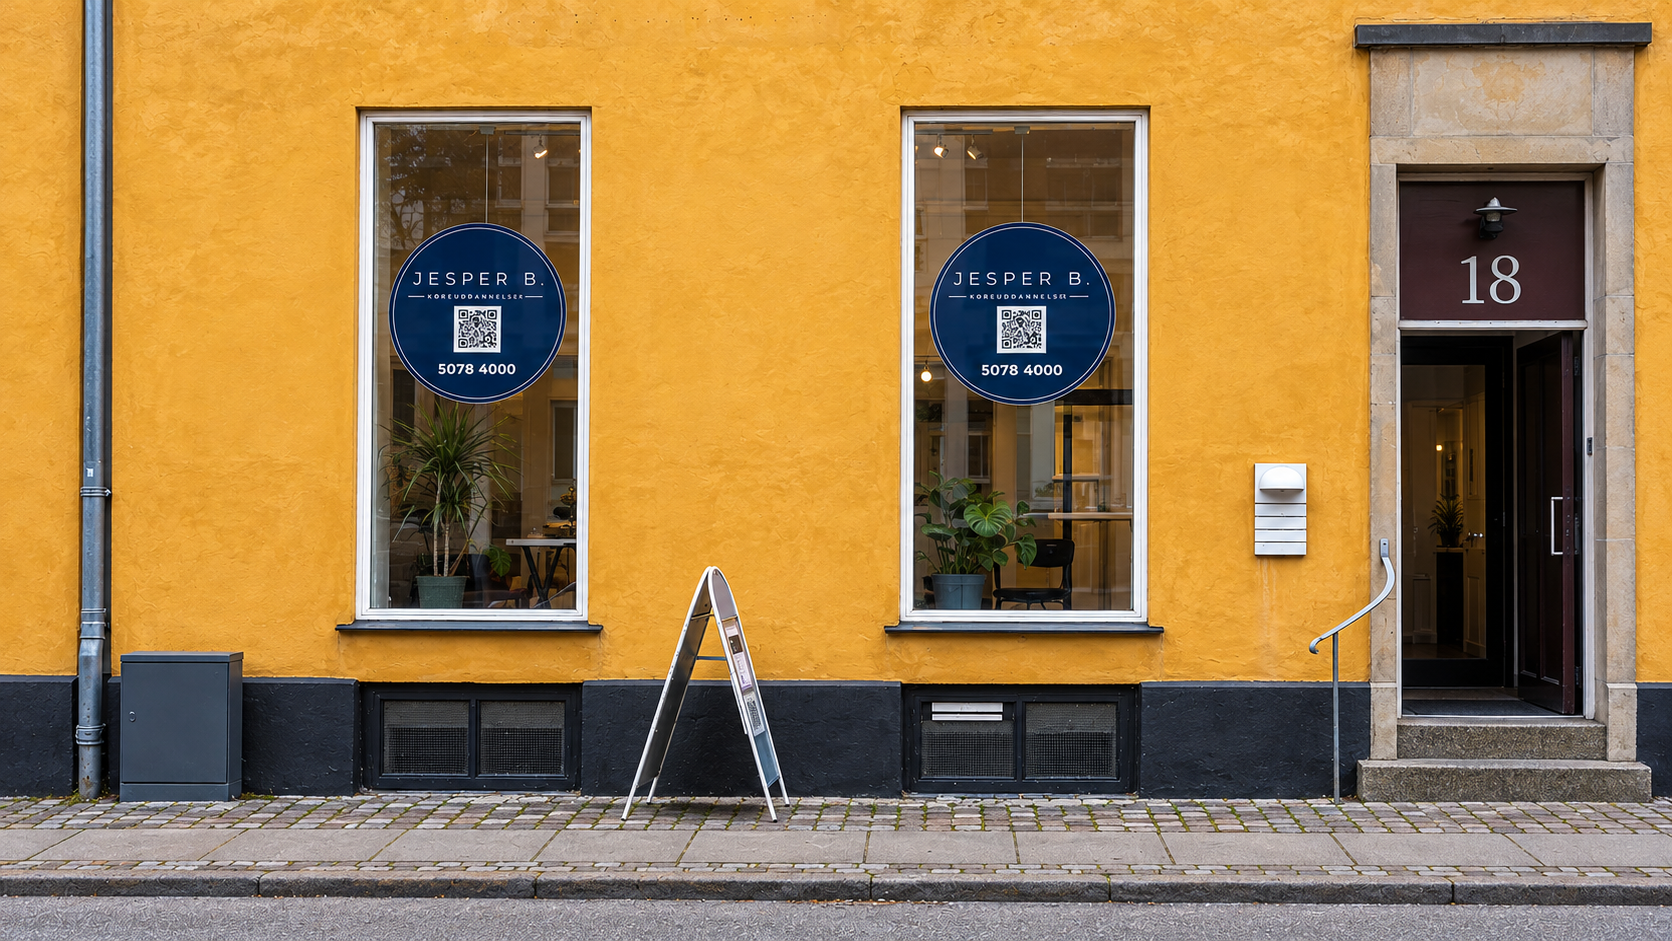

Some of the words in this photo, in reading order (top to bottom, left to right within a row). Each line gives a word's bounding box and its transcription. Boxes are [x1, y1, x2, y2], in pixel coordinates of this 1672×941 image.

[413, 272, 508, 286] JESPER
[524, 272, 544, 286] B.
[953, 272, 1051, 286] JESPER
[1069, 272, 1090, 286] B.
[1460, 255, 1522, 304] 18
[438, 363, 474, 375] 5078
[478, 363, 516, 375] 4000
[981, 364, 1019, 376] 5078
[1023, 364, 1063, 376] 4000
